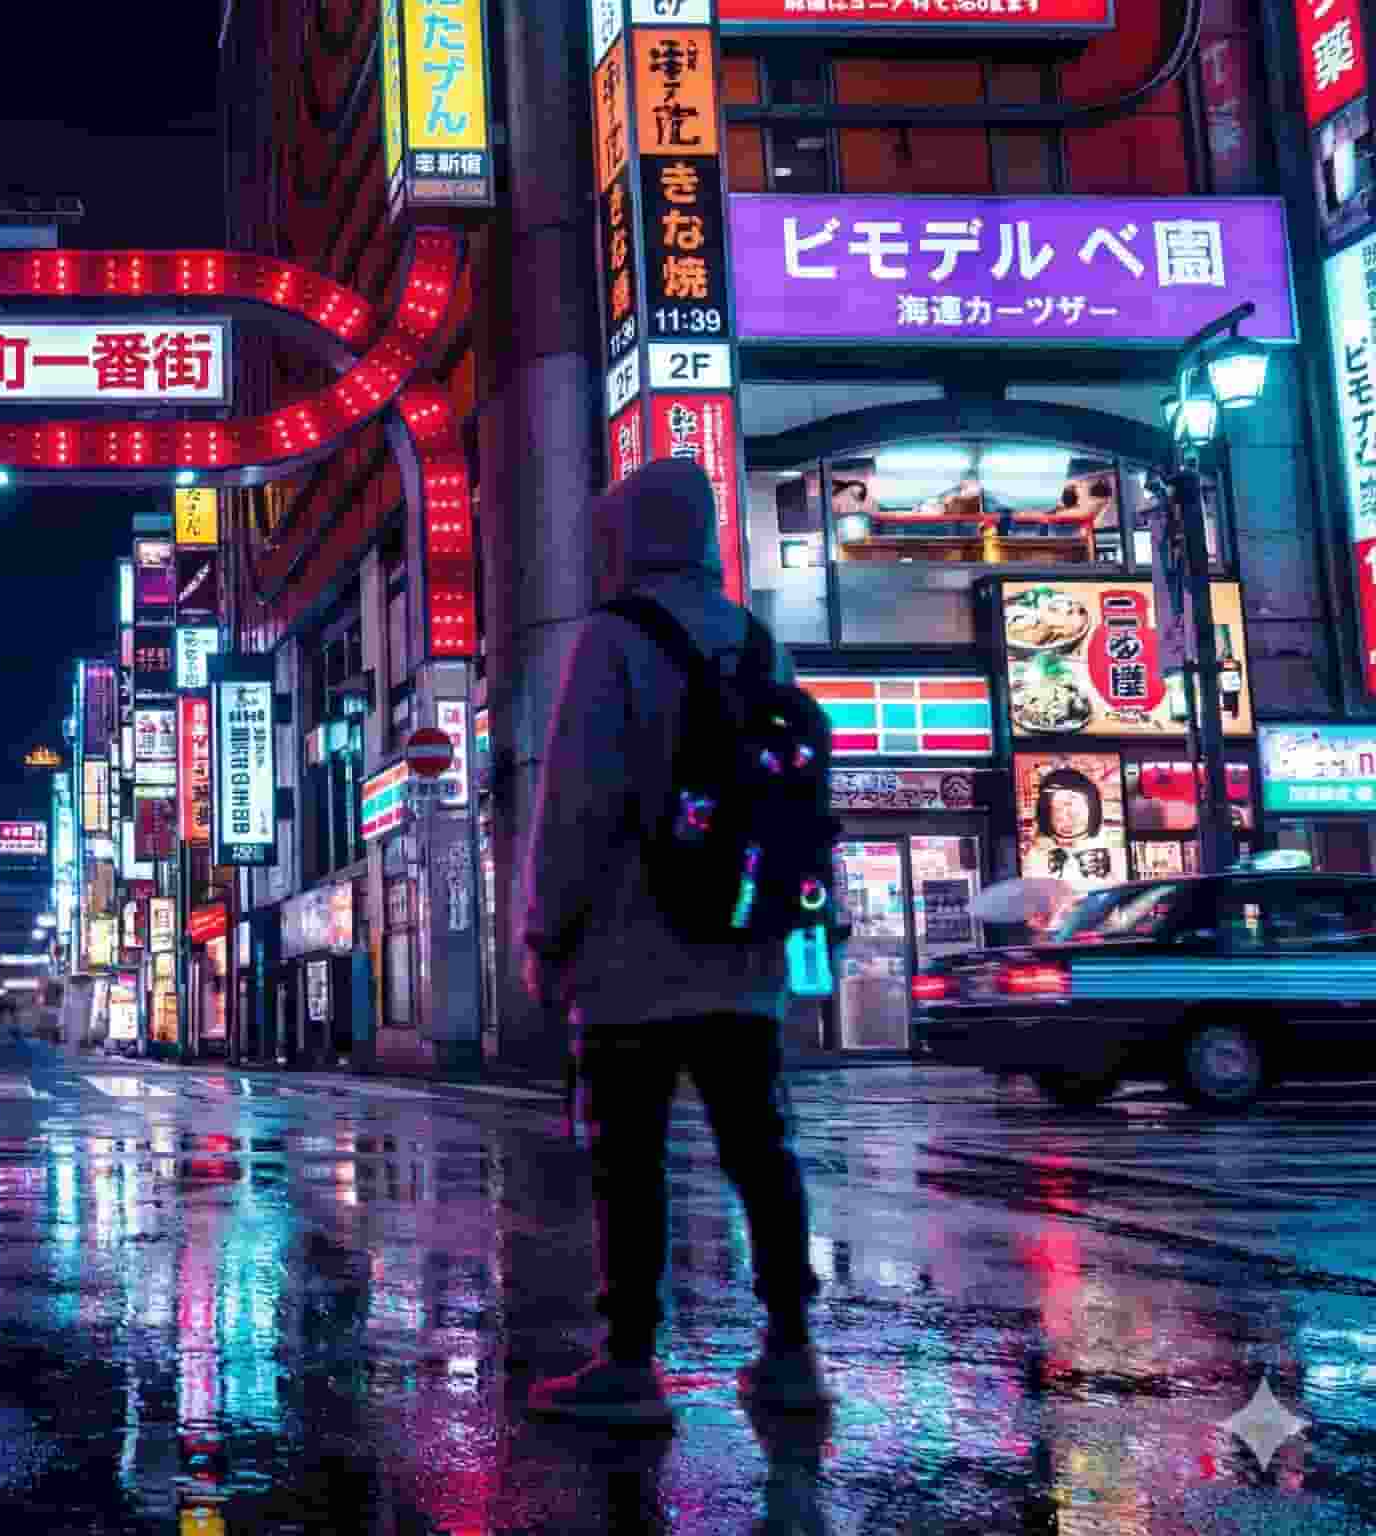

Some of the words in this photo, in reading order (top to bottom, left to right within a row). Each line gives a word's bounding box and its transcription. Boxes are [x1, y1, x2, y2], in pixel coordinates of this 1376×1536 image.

[660, 162, 709, 298] きな焼
[782, 217, 1055, 282] ビモデル
[655, 307, 721, 333] 11:39
[669, 352, 713, 380] 2F
